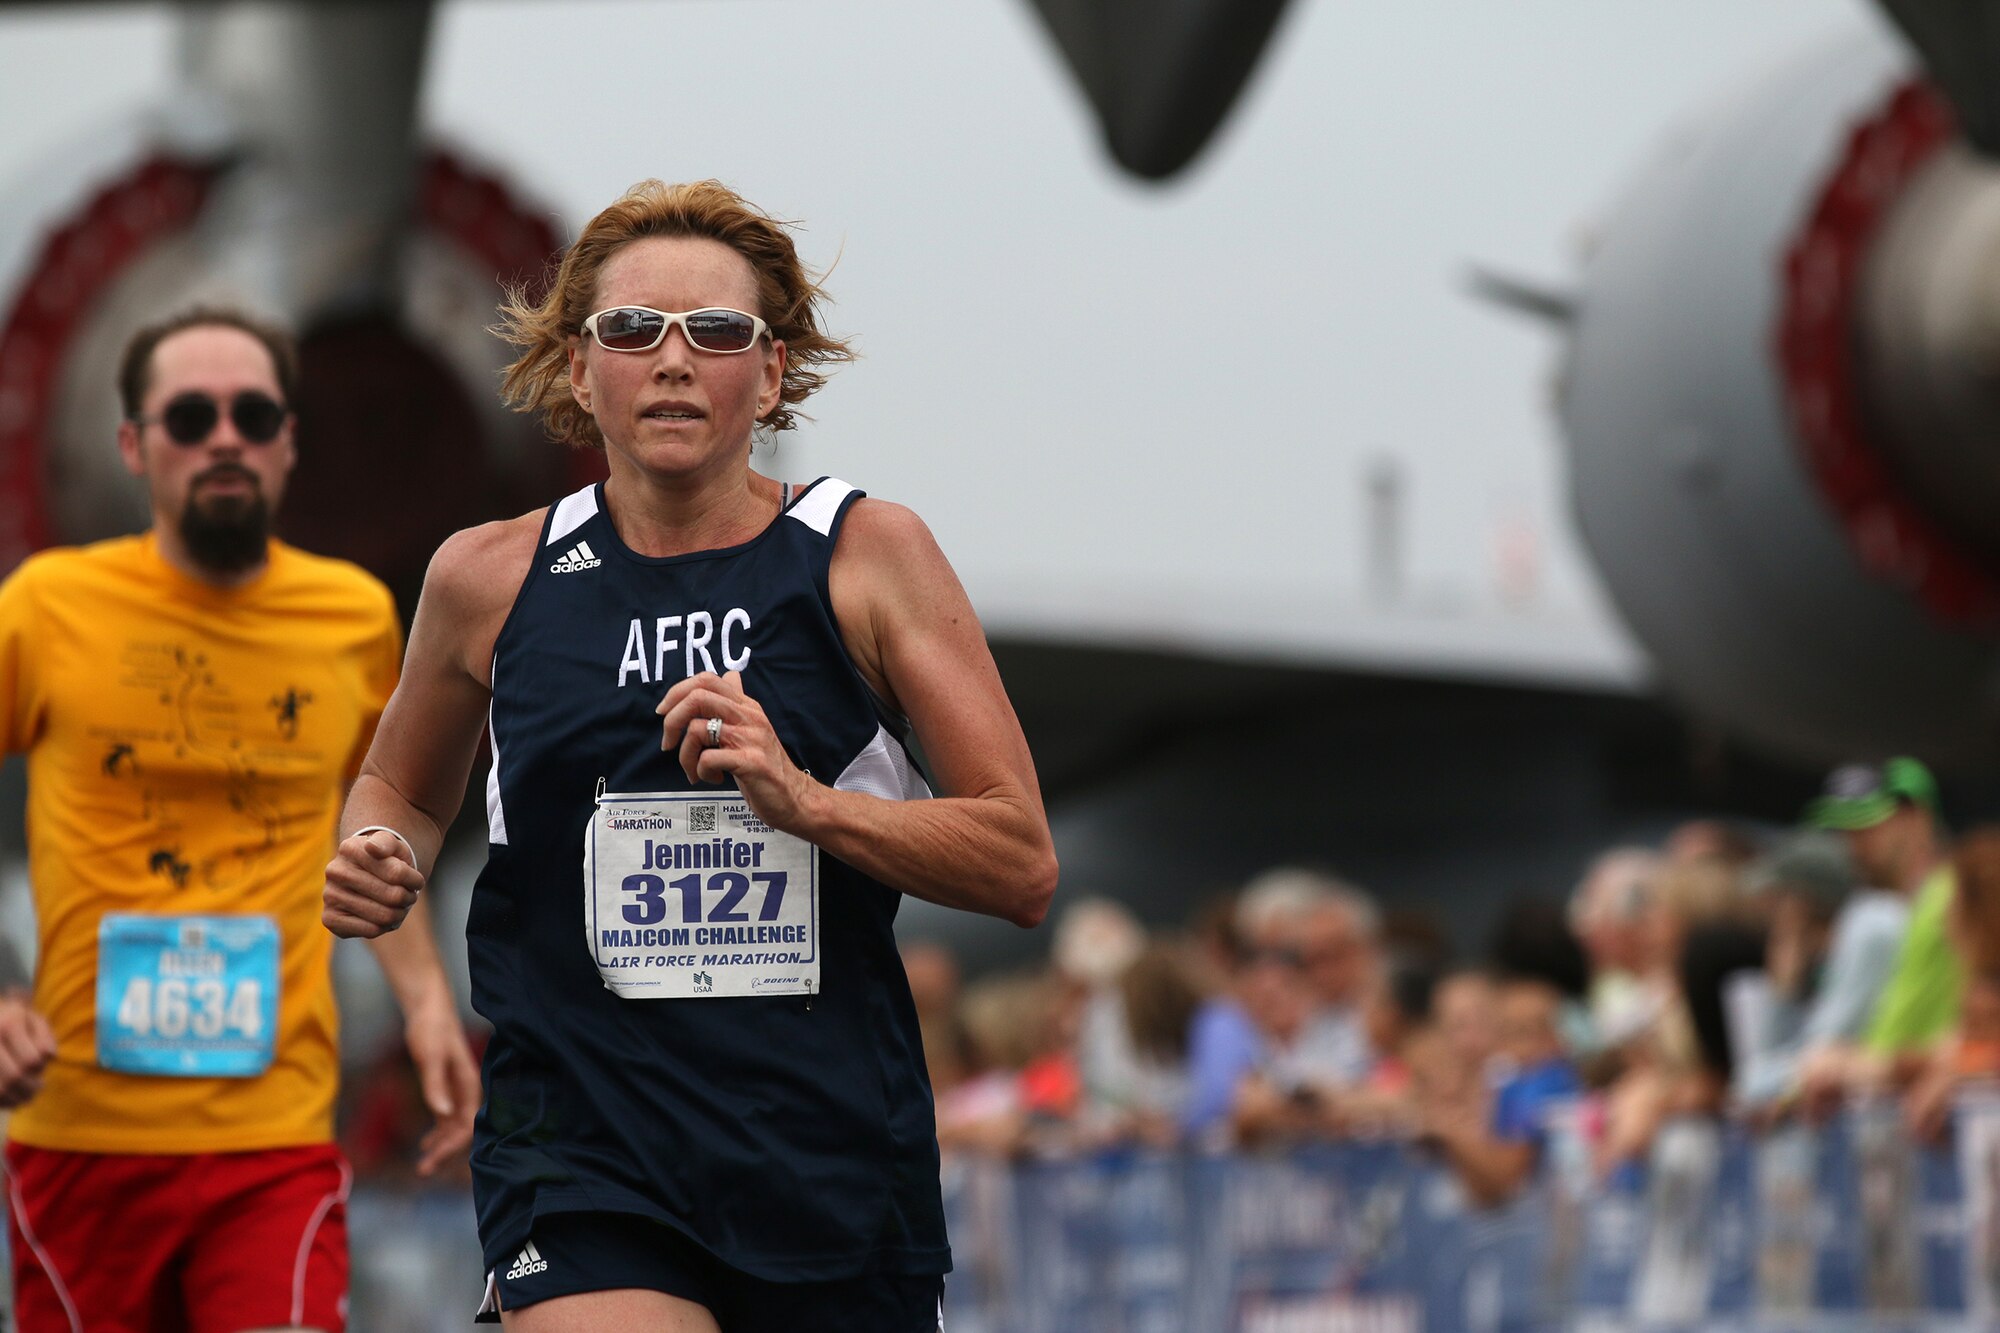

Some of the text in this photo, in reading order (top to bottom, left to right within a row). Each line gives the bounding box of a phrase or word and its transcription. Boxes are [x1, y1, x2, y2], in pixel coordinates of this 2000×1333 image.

[550, 559, 601, 573] adidas
[618, 608, 751, 687] AFRC
[614, 818, 672, 830] MARATHON
[642, 838, 764, 869] Jennifer
[621, 871, 787, 925] 3127
[602, 925, 806, 947] MAJCOM CHALLENGE
[609, 952, 800, 968] AIR FORCE MARATHON
[118, 977, 262, 1038] 4634
[506, 1260, 548, 1280] adidas
